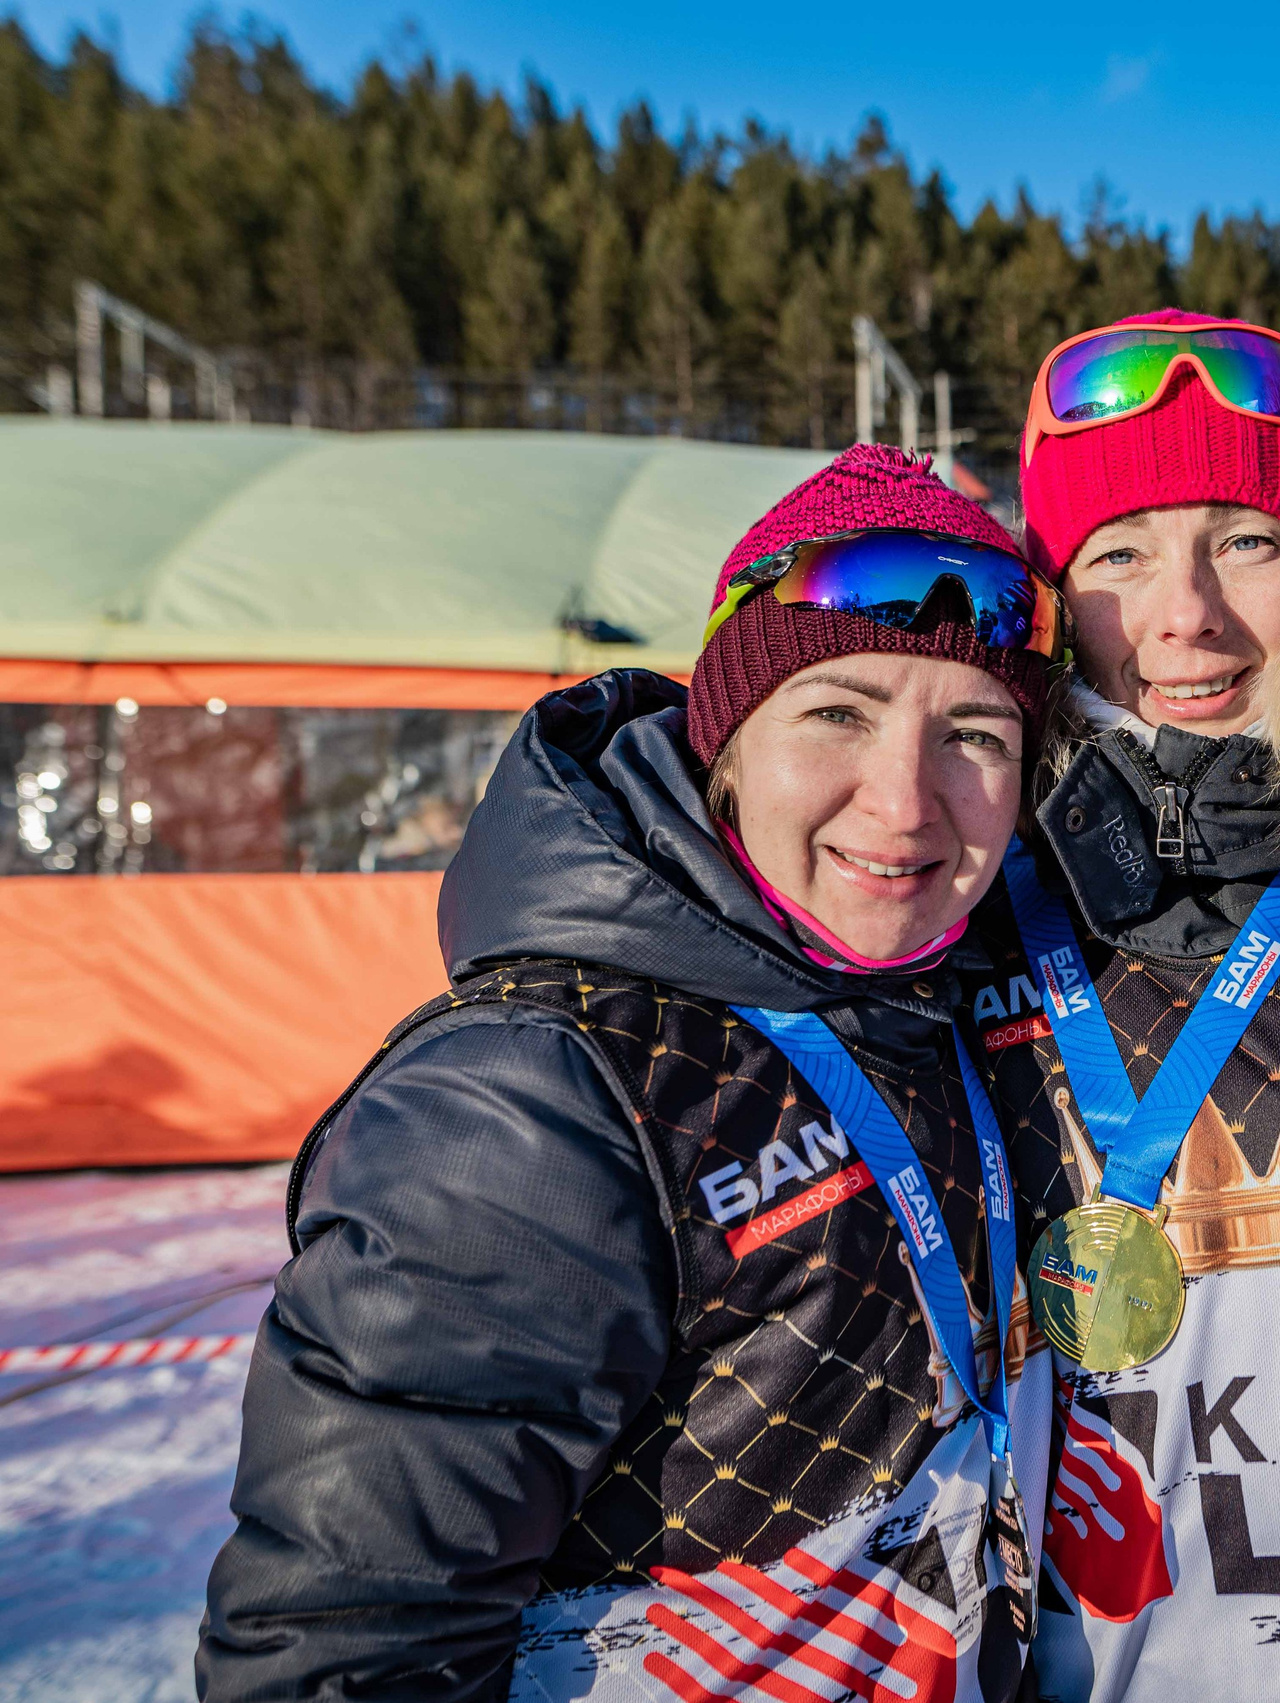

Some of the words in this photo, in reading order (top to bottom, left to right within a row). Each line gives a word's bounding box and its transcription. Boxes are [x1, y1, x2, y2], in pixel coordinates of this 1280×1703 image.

[1042, 962, 1063, 1010] МАРАФОНЫ
[1050, 946, 1090, 1015] БАМ
[1215, 930, 1271, 1003] БАМ
[1242, 949, 1278, 999] МАРАФОНЫ
[974, 974, 1040, 1027] АМ
[985, 1019, 1043, 1048] АФОНЫ
[751, 1172, 865, 1242] МАРАФОНЫ
[898, 1165, 943, 1251] БАМ
[980, 1138, 1004, 1220] БАМ
[894, 1187, 924, 1247] МАРАФОНЫ
[1042, 1252, 1098, 1285] БАМ
